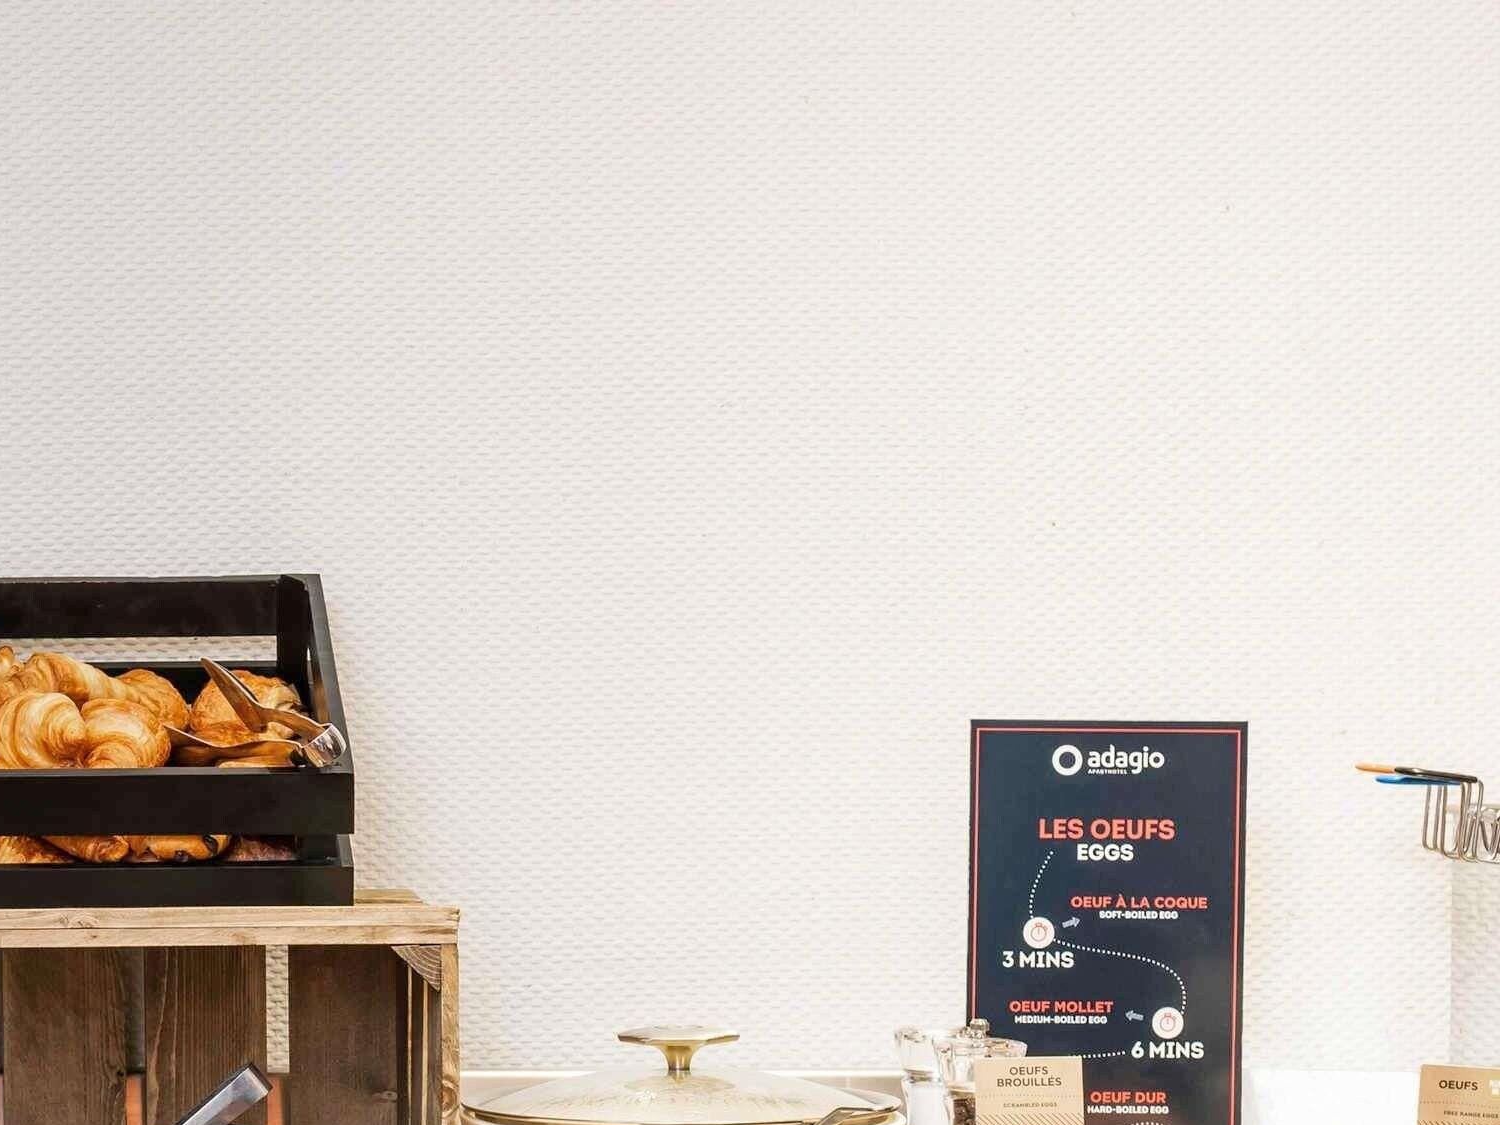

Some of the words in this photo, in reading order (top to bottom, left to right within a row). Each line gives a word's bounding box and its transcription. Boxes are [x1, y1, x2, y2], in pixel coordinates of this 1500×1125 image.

[1087, 744, 1165, 774] adagio
[1038, 818, 1084, 840] LES
[1090, 818, 1176, 840] OEUFS
[1077, 843, 1134, 861] EGGS
[1070, 896, 1111, 909] OEUF
[1116, 893, 1127, 909] À
[1131, 896, 1150, 909] LA
[1154, 896, 1208, 910] COQUE
[1099, 910, 1158, 919] SOFT-BOILED
[1159, 910, 1179, 919] EGG
[1002, 951, 1015, 968] 3
[1019, 951, 1075, 968] MINS
[1009, 1001, 1050, 1013] OEUF
[1055, 1001, 1114, 1013] MOLLET
[1014, 1015, 1087, 1024] MEDIUM-BOILED
[1088, 1015, 1108, 1024] EGG
[1131, 1041, 1146, 1058] 6
[1149, 1041, 1205, 1058] MINS
[1009, 1066, 1049, 1076] OEUFS
[997, 1075, 1062, 1087] BROUILLÉS
[1438, 1080, 1478, 1091] OEUFS
[1090, 1091, 1132, 1104] OEUF
[1134, 1091, 1167, 1104] DUR
[1087, 1105, 1149, 1114] HARD-BOILED
[1150, 1105, 1169, 1114] EGG
